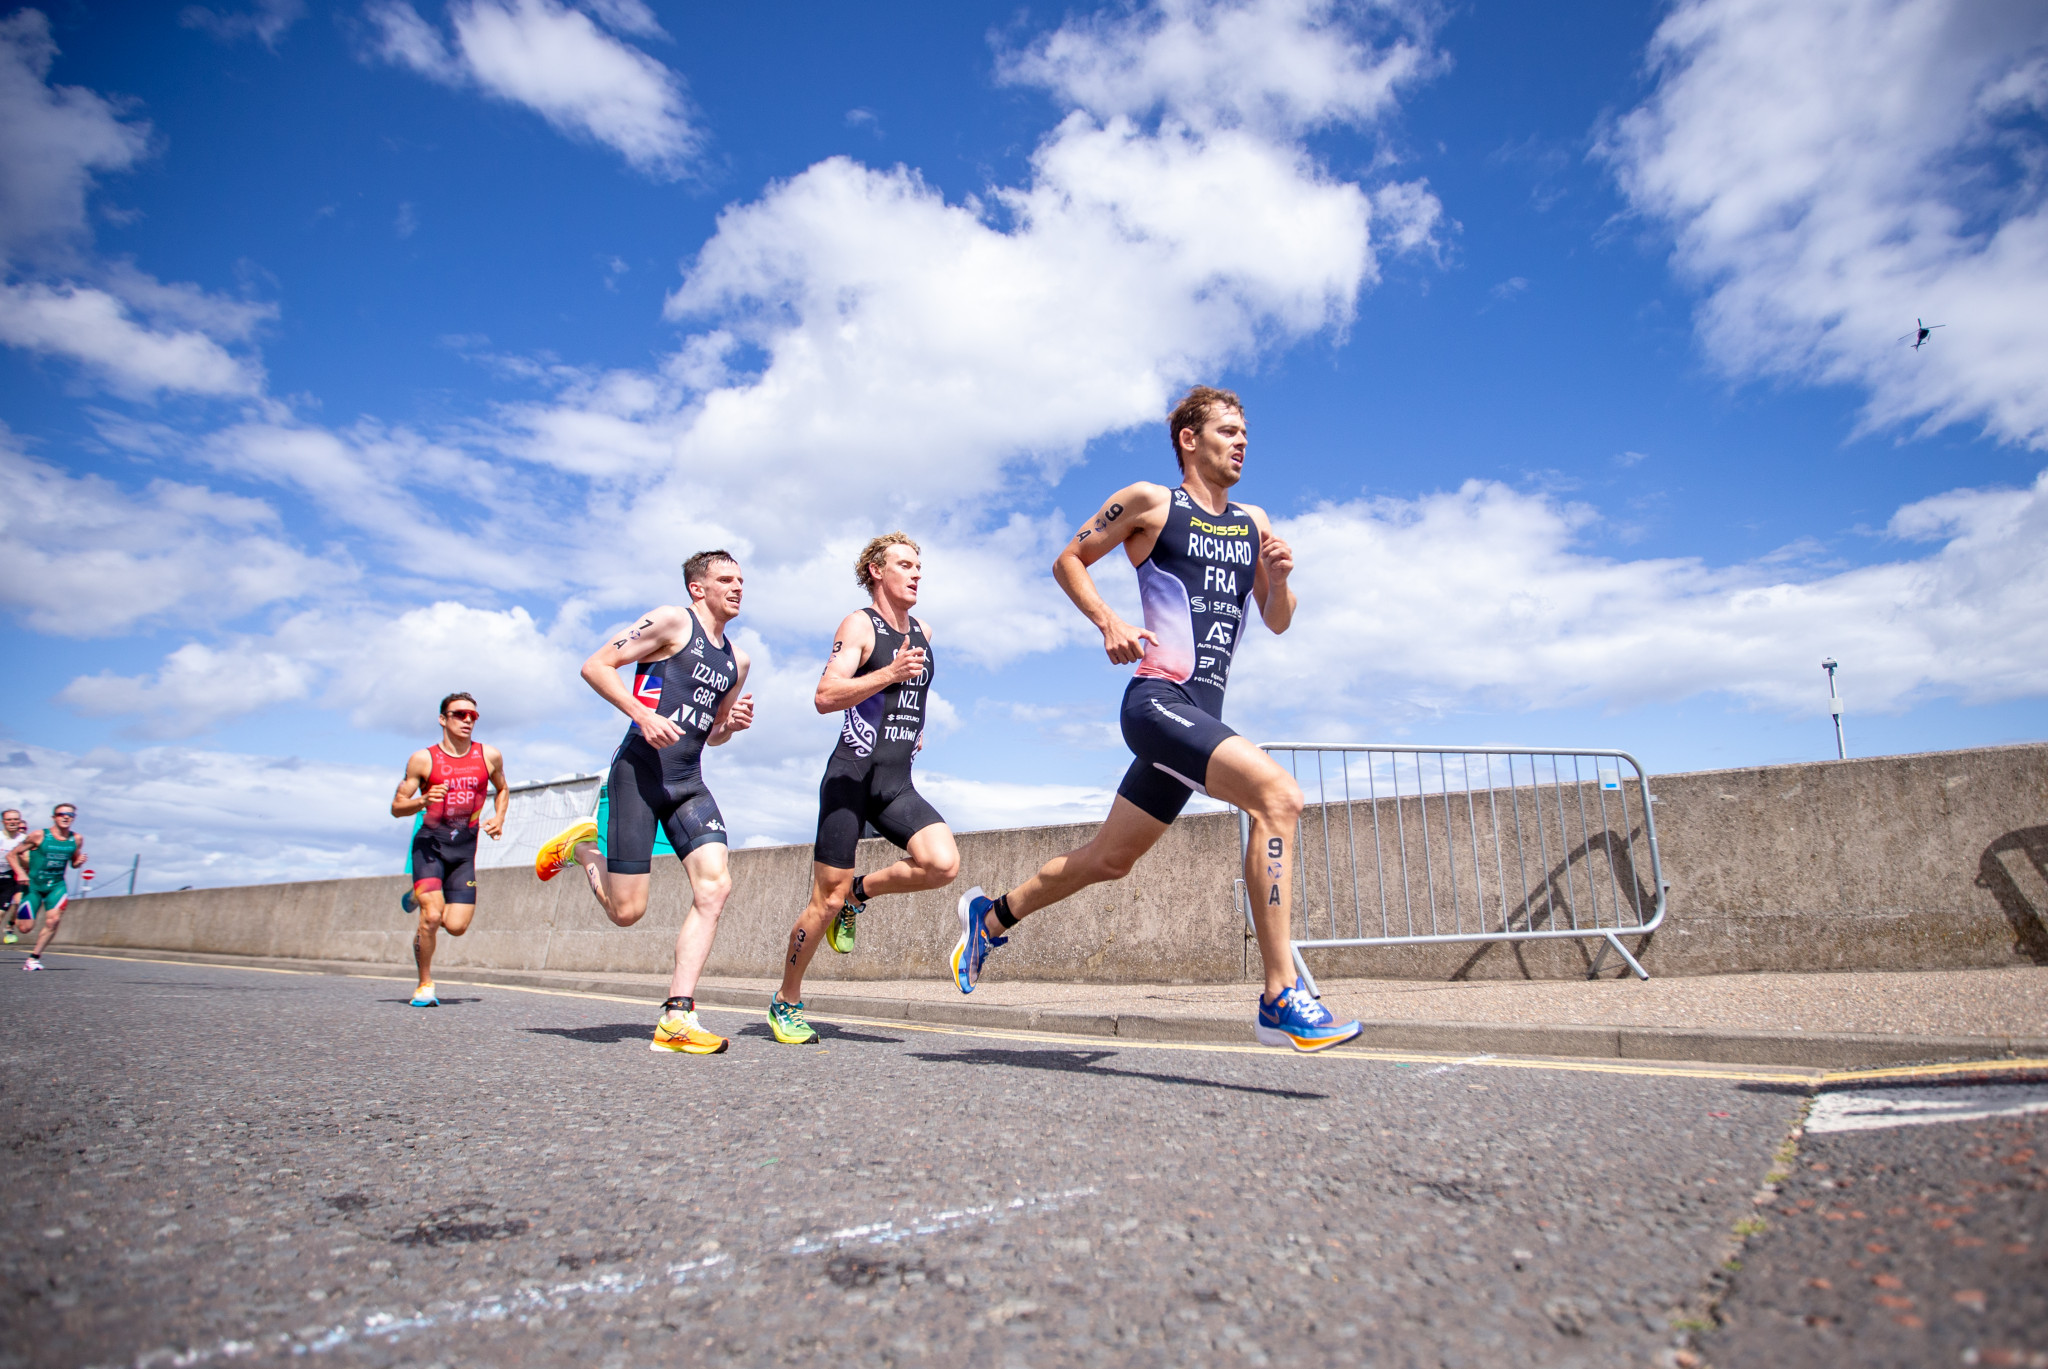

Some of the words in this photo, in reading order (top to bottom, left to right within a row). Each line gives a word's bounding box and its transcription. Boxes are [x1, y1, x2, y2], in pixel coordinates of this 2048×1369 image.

[1105, 503, 1124, 521] 9
[1189, 516, 1249, 536] POISSY
[1077, 530, 1092, 542] A
[1187, 532, 1252, 566] RICHARD
[1203, 565, 1237, 596] FRA
[639, 619, 654, 630] 7
[613, 638, 628, 650] A
[832, 641, 843, 653] 3
[691, 662, 730, 692] IZZARD
[693, 687, 716, 709] GBR
[898, 690, 920, 710] NZL
[896, 714, 920, 723] SUZUKI
[884, 726, 917, 742] TQ.kiwi
[447, 791, 475, 805] ESP
[1268, 837, 1283, 858] 9
[1268, 884, 1281, 905] A
[796, 929, 807, 942] 3
[789, 954, 797, 966] A
